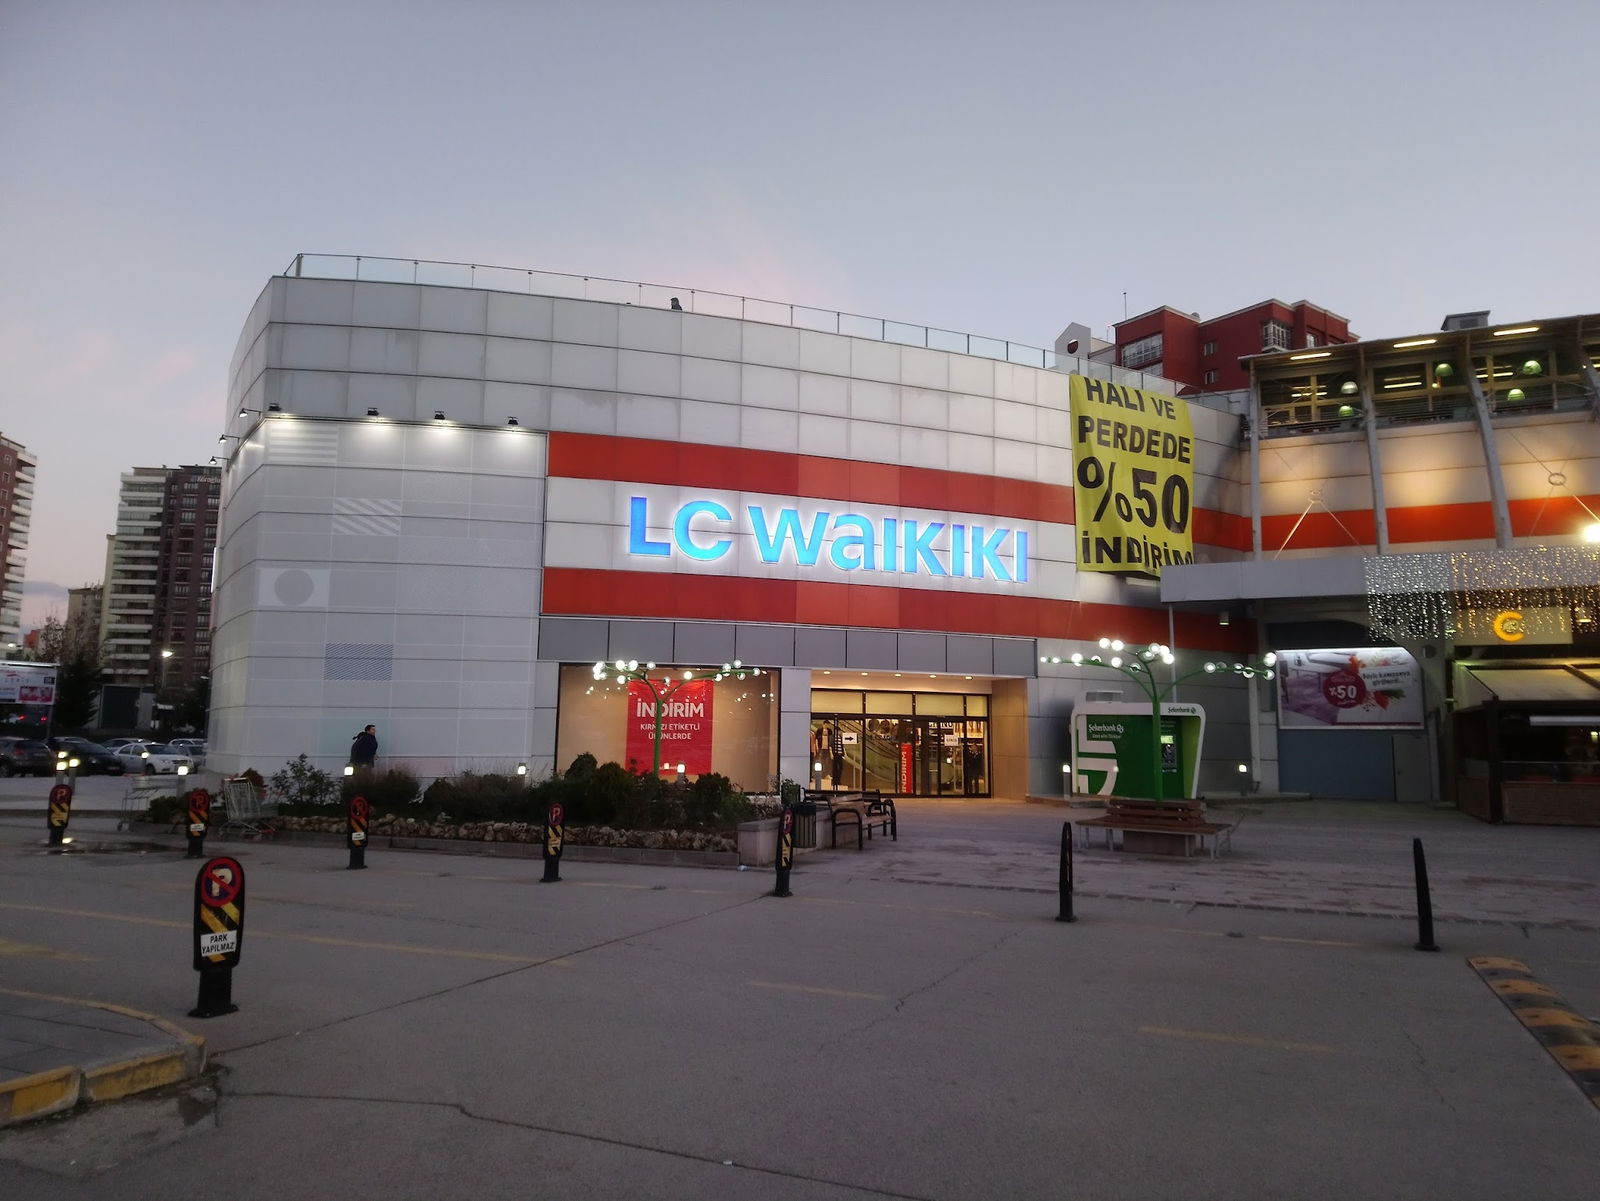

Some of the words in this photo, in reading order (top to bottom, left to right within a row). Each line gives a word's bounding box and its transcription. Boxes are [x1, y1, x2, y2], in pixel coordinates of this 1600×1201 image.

[1083, 377, 1146, 413] HALI
[1150, 396, 1177, 420] VE
[1078, 415, 1191, 464] PERDEDE
[1077, 456, 1190, 534] %50
[629, 496, 733, 562] LC
[1328, 685, 1357, 700] %50
[637, 698, 704, 718] İNDİRİM
[640, 723, 668, 731] KIRMZI
[668, 722, 700, 731] ETİKETLİ
[648, 732, 692, 740] ÜNLERDE
[210, 934, 228, 943] PARK
[201, 942, 235, 954] YAPILMAZ
